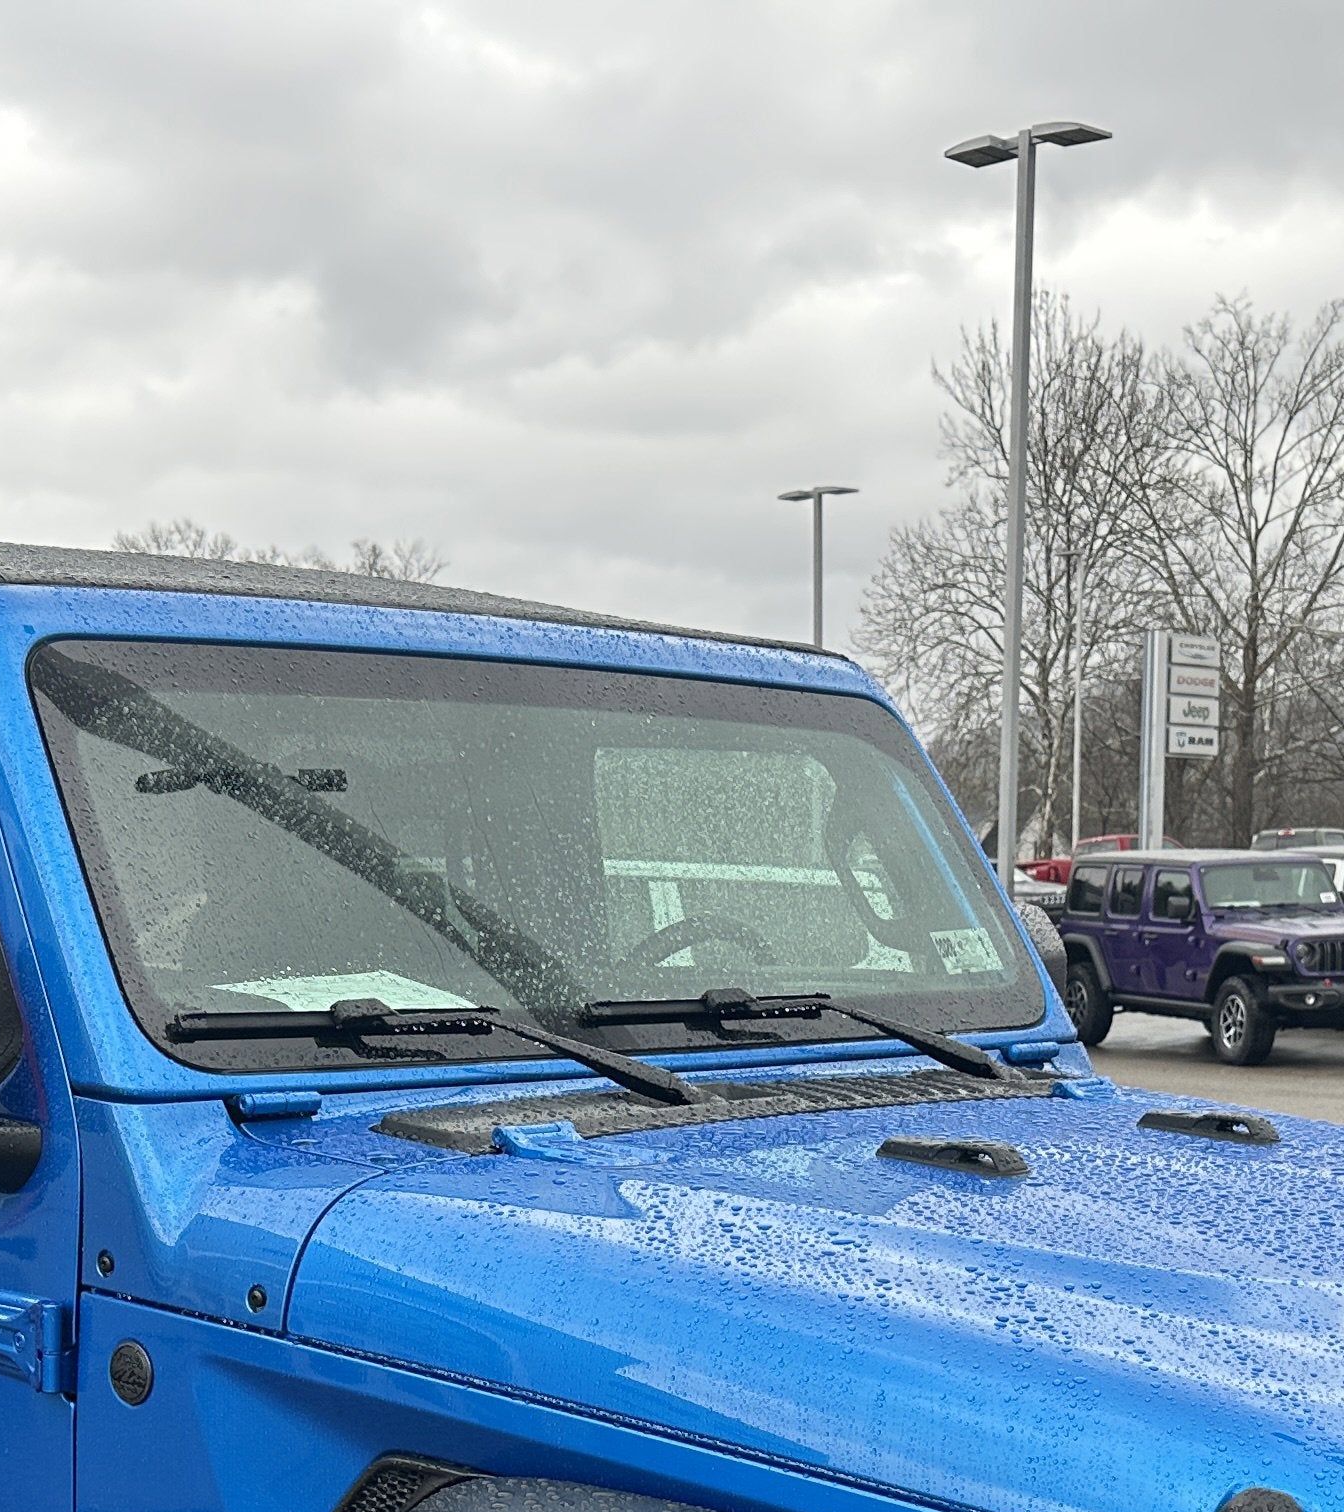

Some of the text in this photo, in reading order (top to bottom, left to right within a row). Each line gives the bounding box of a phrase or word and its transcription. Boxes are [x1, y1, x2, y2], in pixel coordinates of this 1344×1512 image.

[1177, 675, 1216, 688] DODGE
[1182, 701, 1210, 722] Jeep
[1188, 736, 1214, 746] RAM
